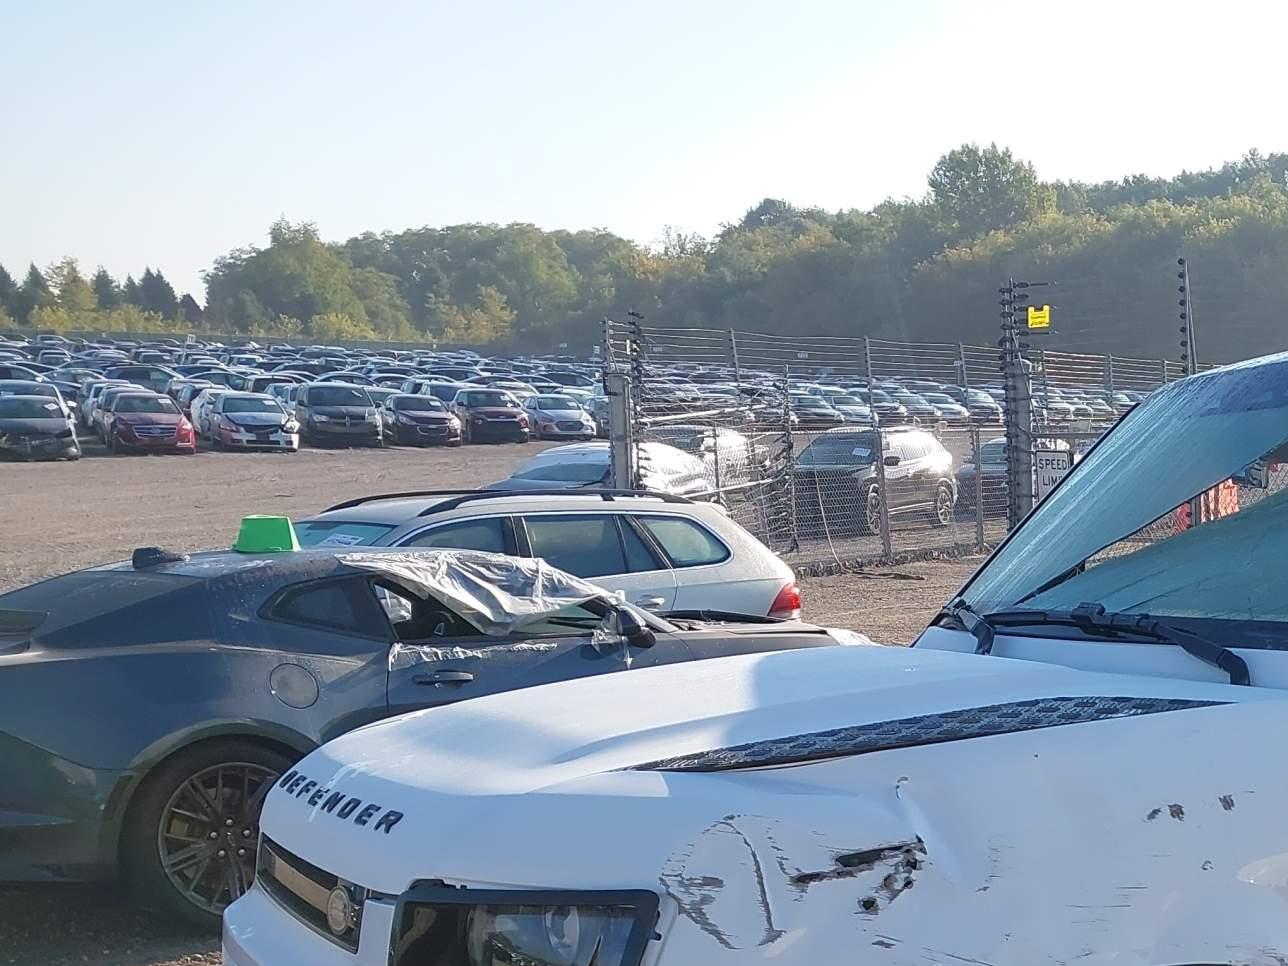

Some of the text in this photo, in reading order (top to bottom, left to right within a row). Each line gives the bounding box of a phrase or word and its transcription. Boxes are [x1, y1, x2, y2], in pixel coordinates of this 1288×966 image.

[1038, 458, 1068, 470] SPEED
[1042, 475, 1063, 487] LIM
[279, 769, 405, 835] DEFENDER
